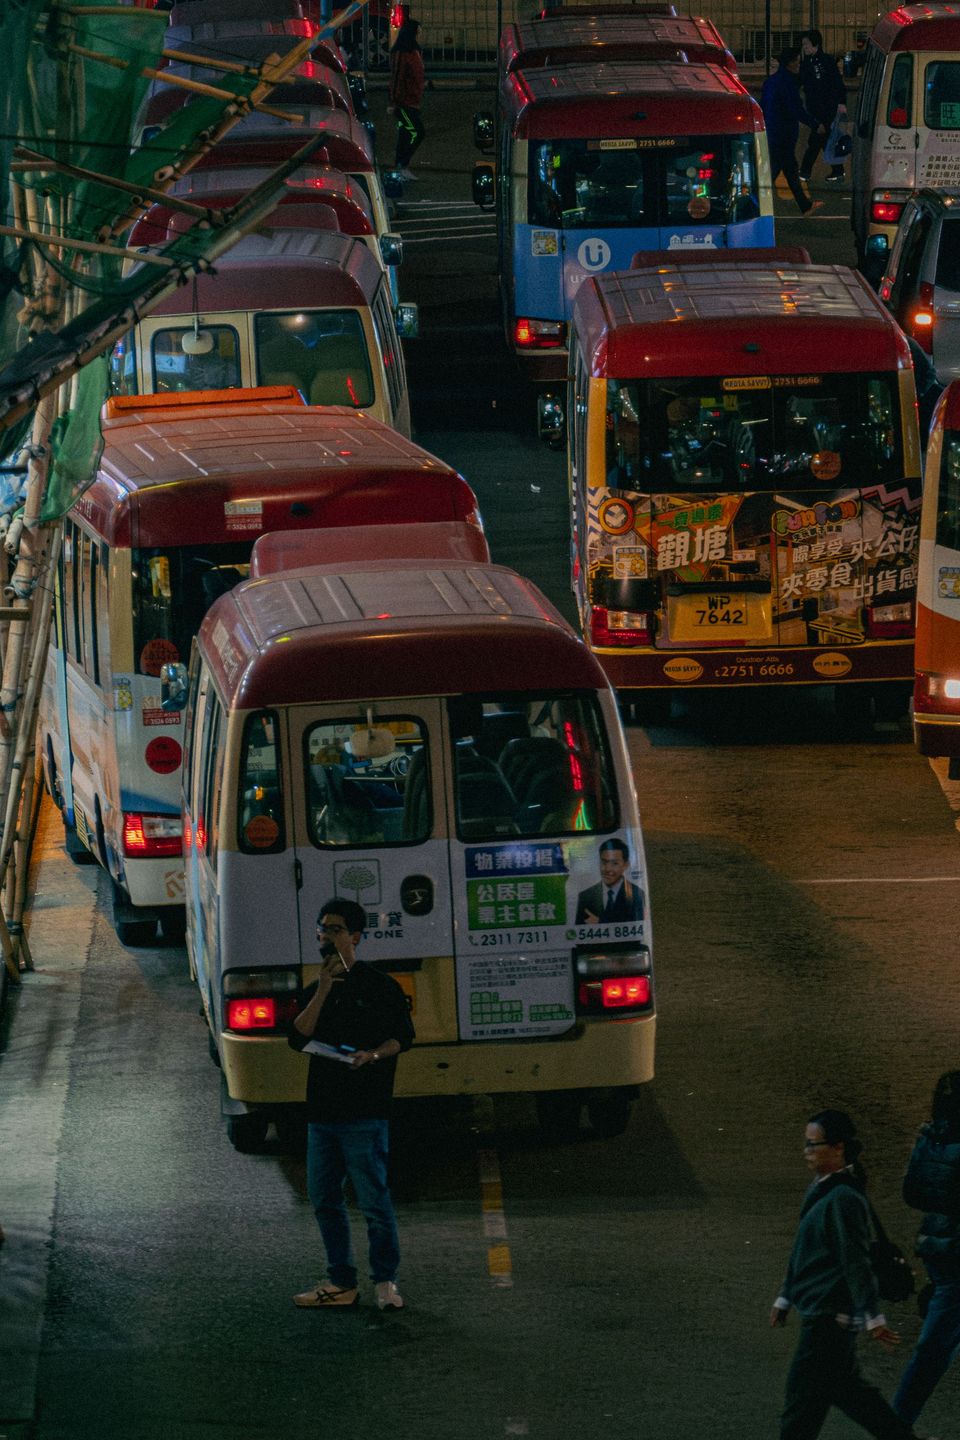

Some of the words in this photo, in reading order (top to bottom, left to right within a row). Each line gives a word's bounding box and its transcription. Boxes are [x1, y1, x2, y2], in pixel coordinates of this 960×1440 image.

[656, 524, 728, 571] 觀塘
[779, 561, 854, 600] 夾零食
[707, 596, 731, 610] WP
[695, 610, 744, 624] 7642
[721, 664, 754, 677] 2751
[760, 663, 793, 676] 6666
[373, 929, 404, 939] ONE
[481, 934, 511, 946] 2311
[517, 931, 548, 944] 7311
[578, 926, 613, 940] 5444
[614, 924, 644, 939] 8844
